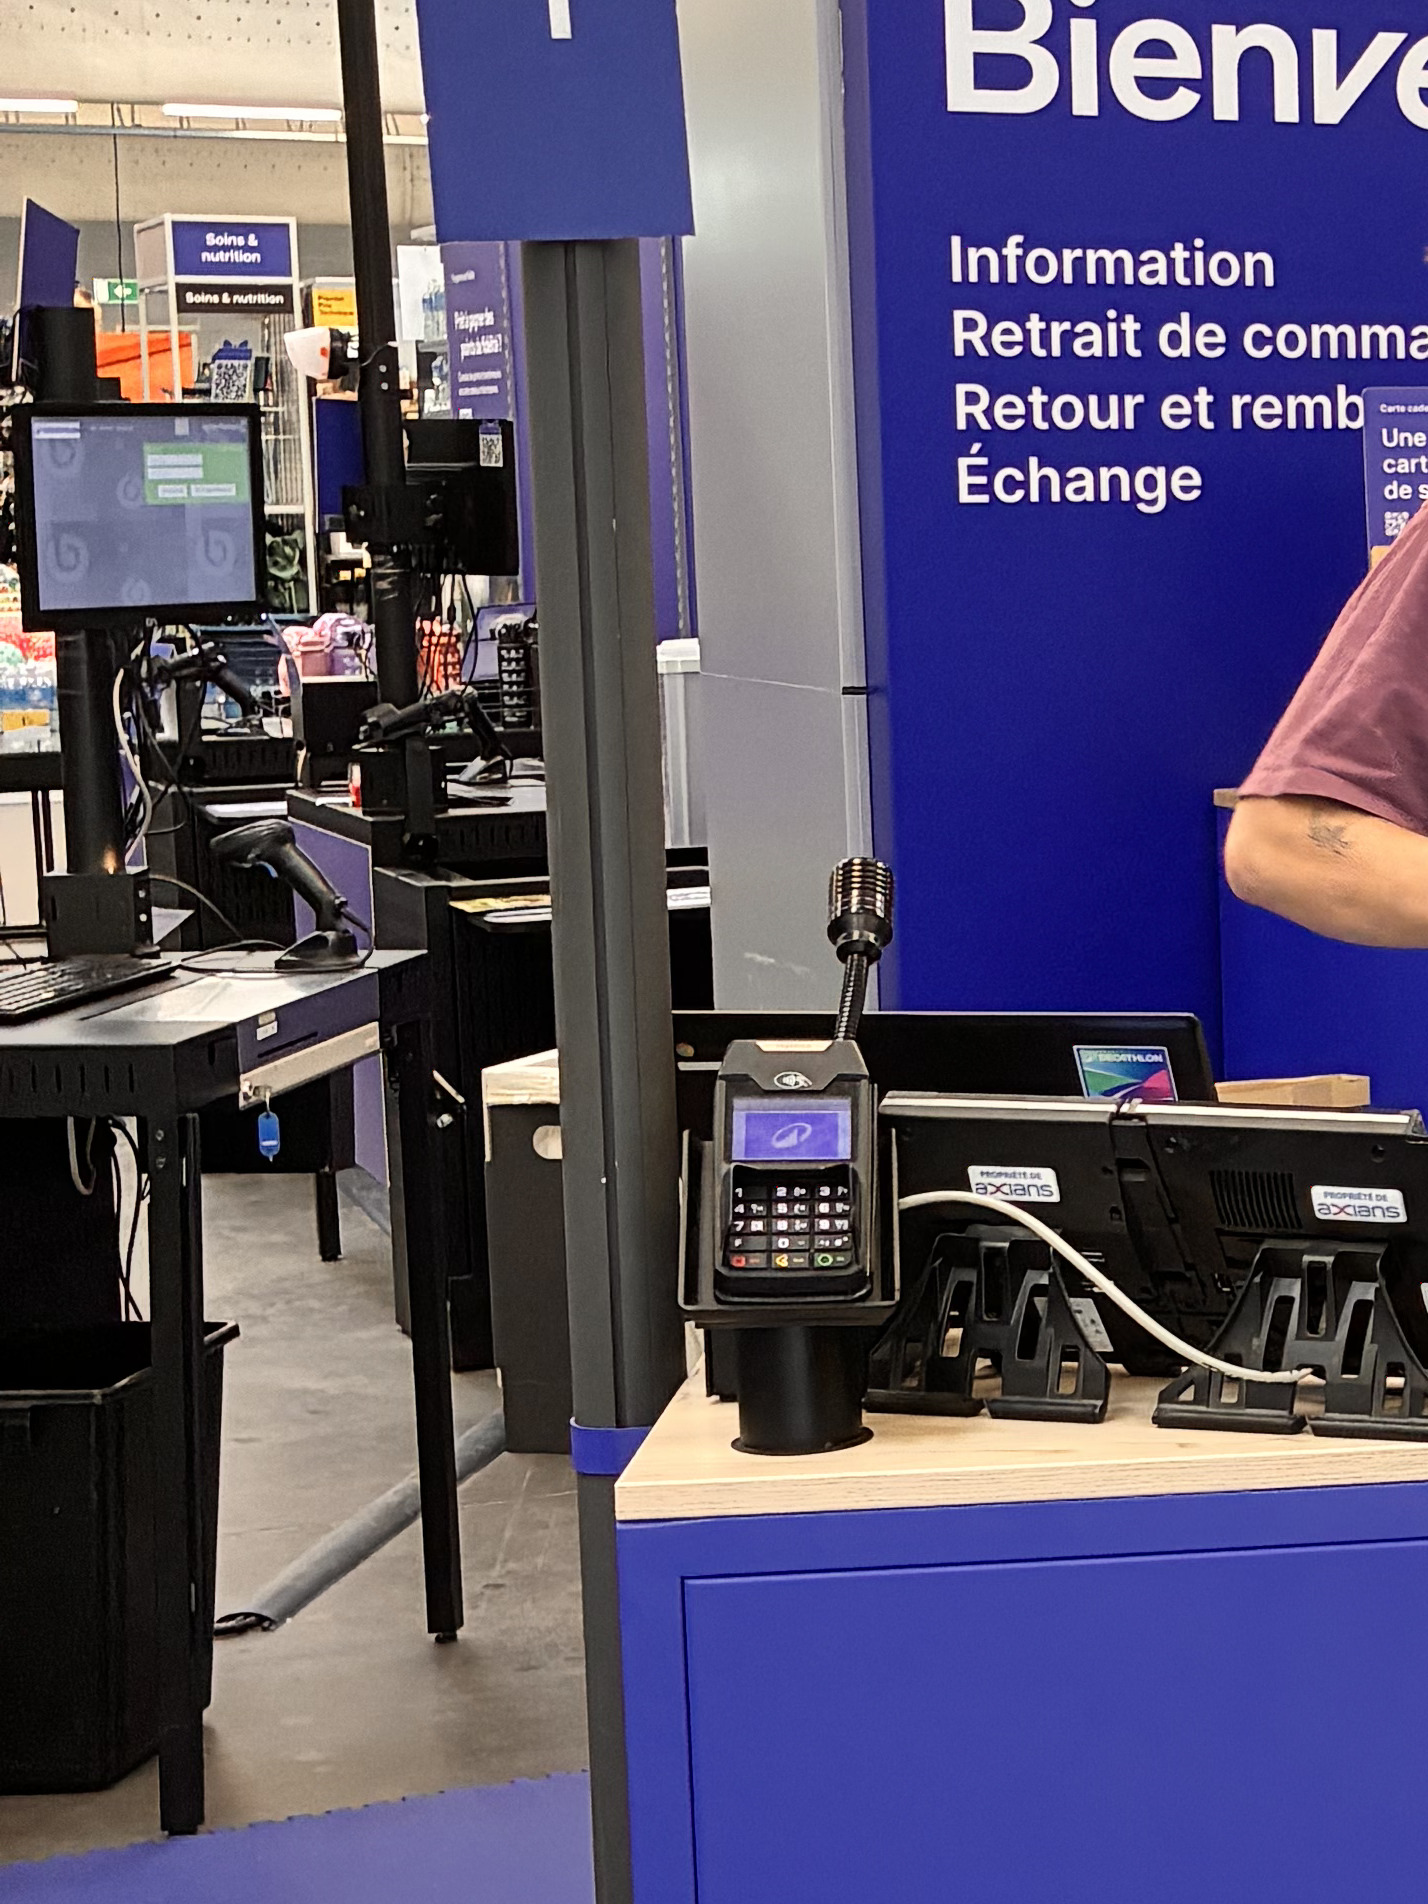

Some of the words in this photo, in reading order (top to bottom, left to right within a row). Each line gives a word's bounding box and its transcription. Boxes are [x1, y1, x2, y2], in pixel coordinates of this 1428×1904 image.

[205, 232, 245, 246] Soins
[248, 233, 258, 246] &
[201, 249, 261, 263] nutrition
[950, 234, 1275, 287] Information
[185, 291, 219, 304] Soins
[222, 292, 231, 304] &
[233, 293, 284, 304] nutrition
[953, 309, 1142, 358] Retrait
[1158, 311, 1227, 358] de
[955, 382, 1145, 431] Retour
[1160, 386, 1215, 431] et
[1381, 427, 1427, 448] Une
[957, 441, 1202, 514] Échange
[1384, 480, 1413, 500] de
